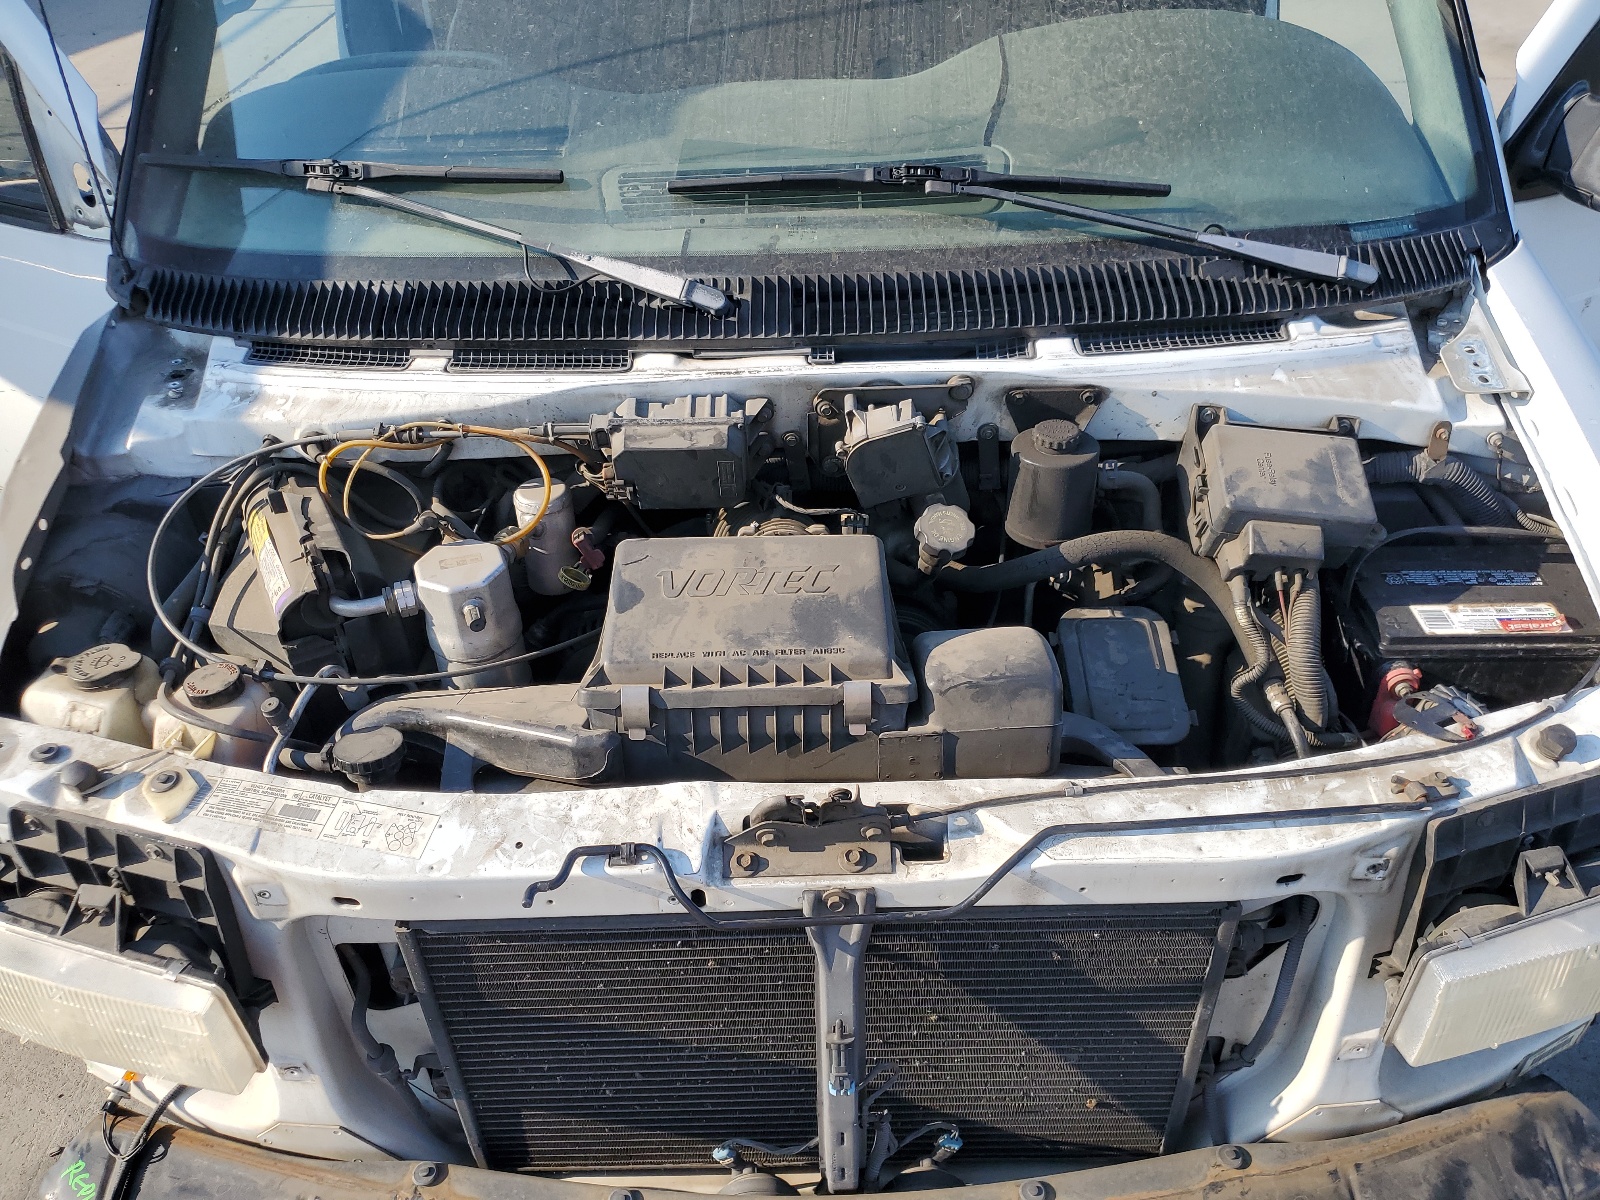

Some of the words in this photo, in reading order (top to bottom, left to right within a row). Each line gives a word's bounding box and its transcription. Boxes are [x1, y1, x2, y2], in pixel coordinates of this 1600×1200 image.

[655, 564, 841, 599] VORTEC
[1508, 618, 1564, 630] Duralast
[651, 650, 696, 659] REPLACE
[702, 649, 726, 658] WITH
[732, 648, 746, 657] AC
[752, 648, 770, 657] AIR
[775, 648, 806, 656] FILTER
[308, 792, 332, 802] CATALYST
